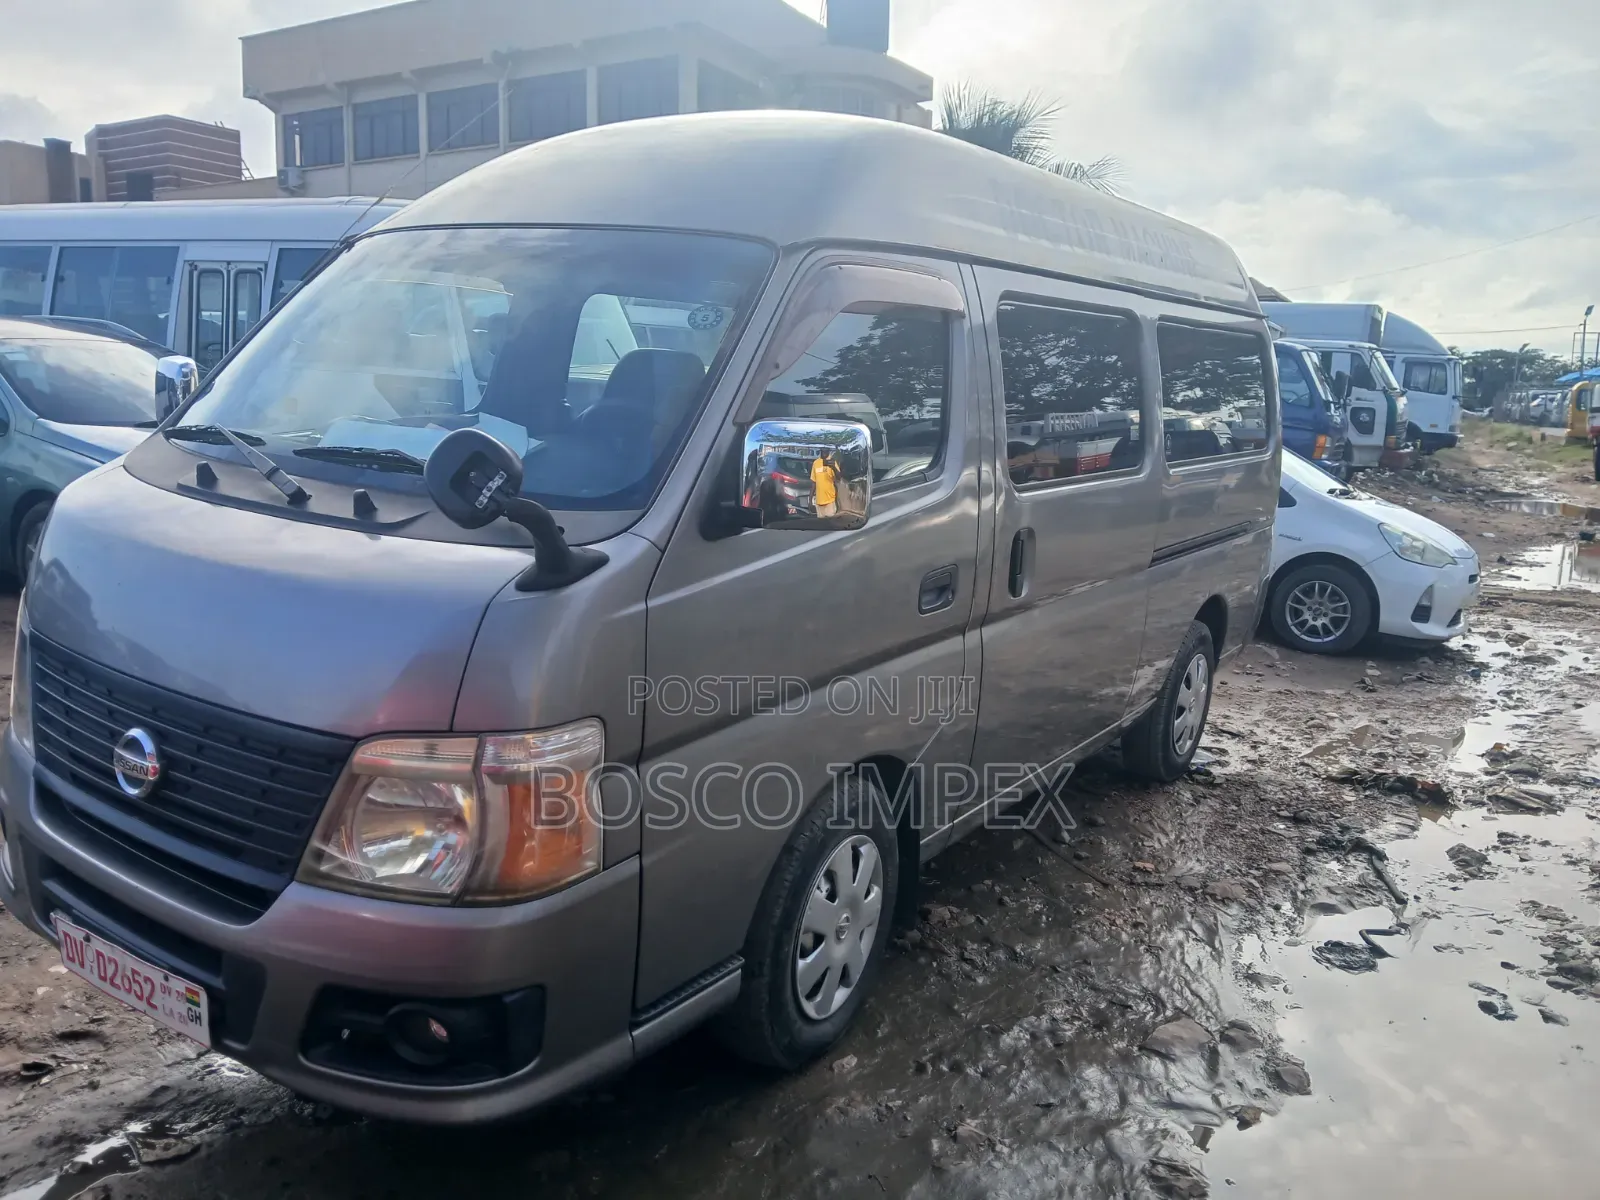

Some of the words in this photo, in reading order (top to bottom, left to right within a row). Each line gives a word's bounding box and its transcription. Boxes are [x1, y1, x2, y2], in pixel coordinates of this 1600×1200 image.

[116, 756, 149, 777] SSAN
[62, 930, 85, 969] DV
[160, 982, 172, 997] DV
[187, 1007, 202, 1027] GH
